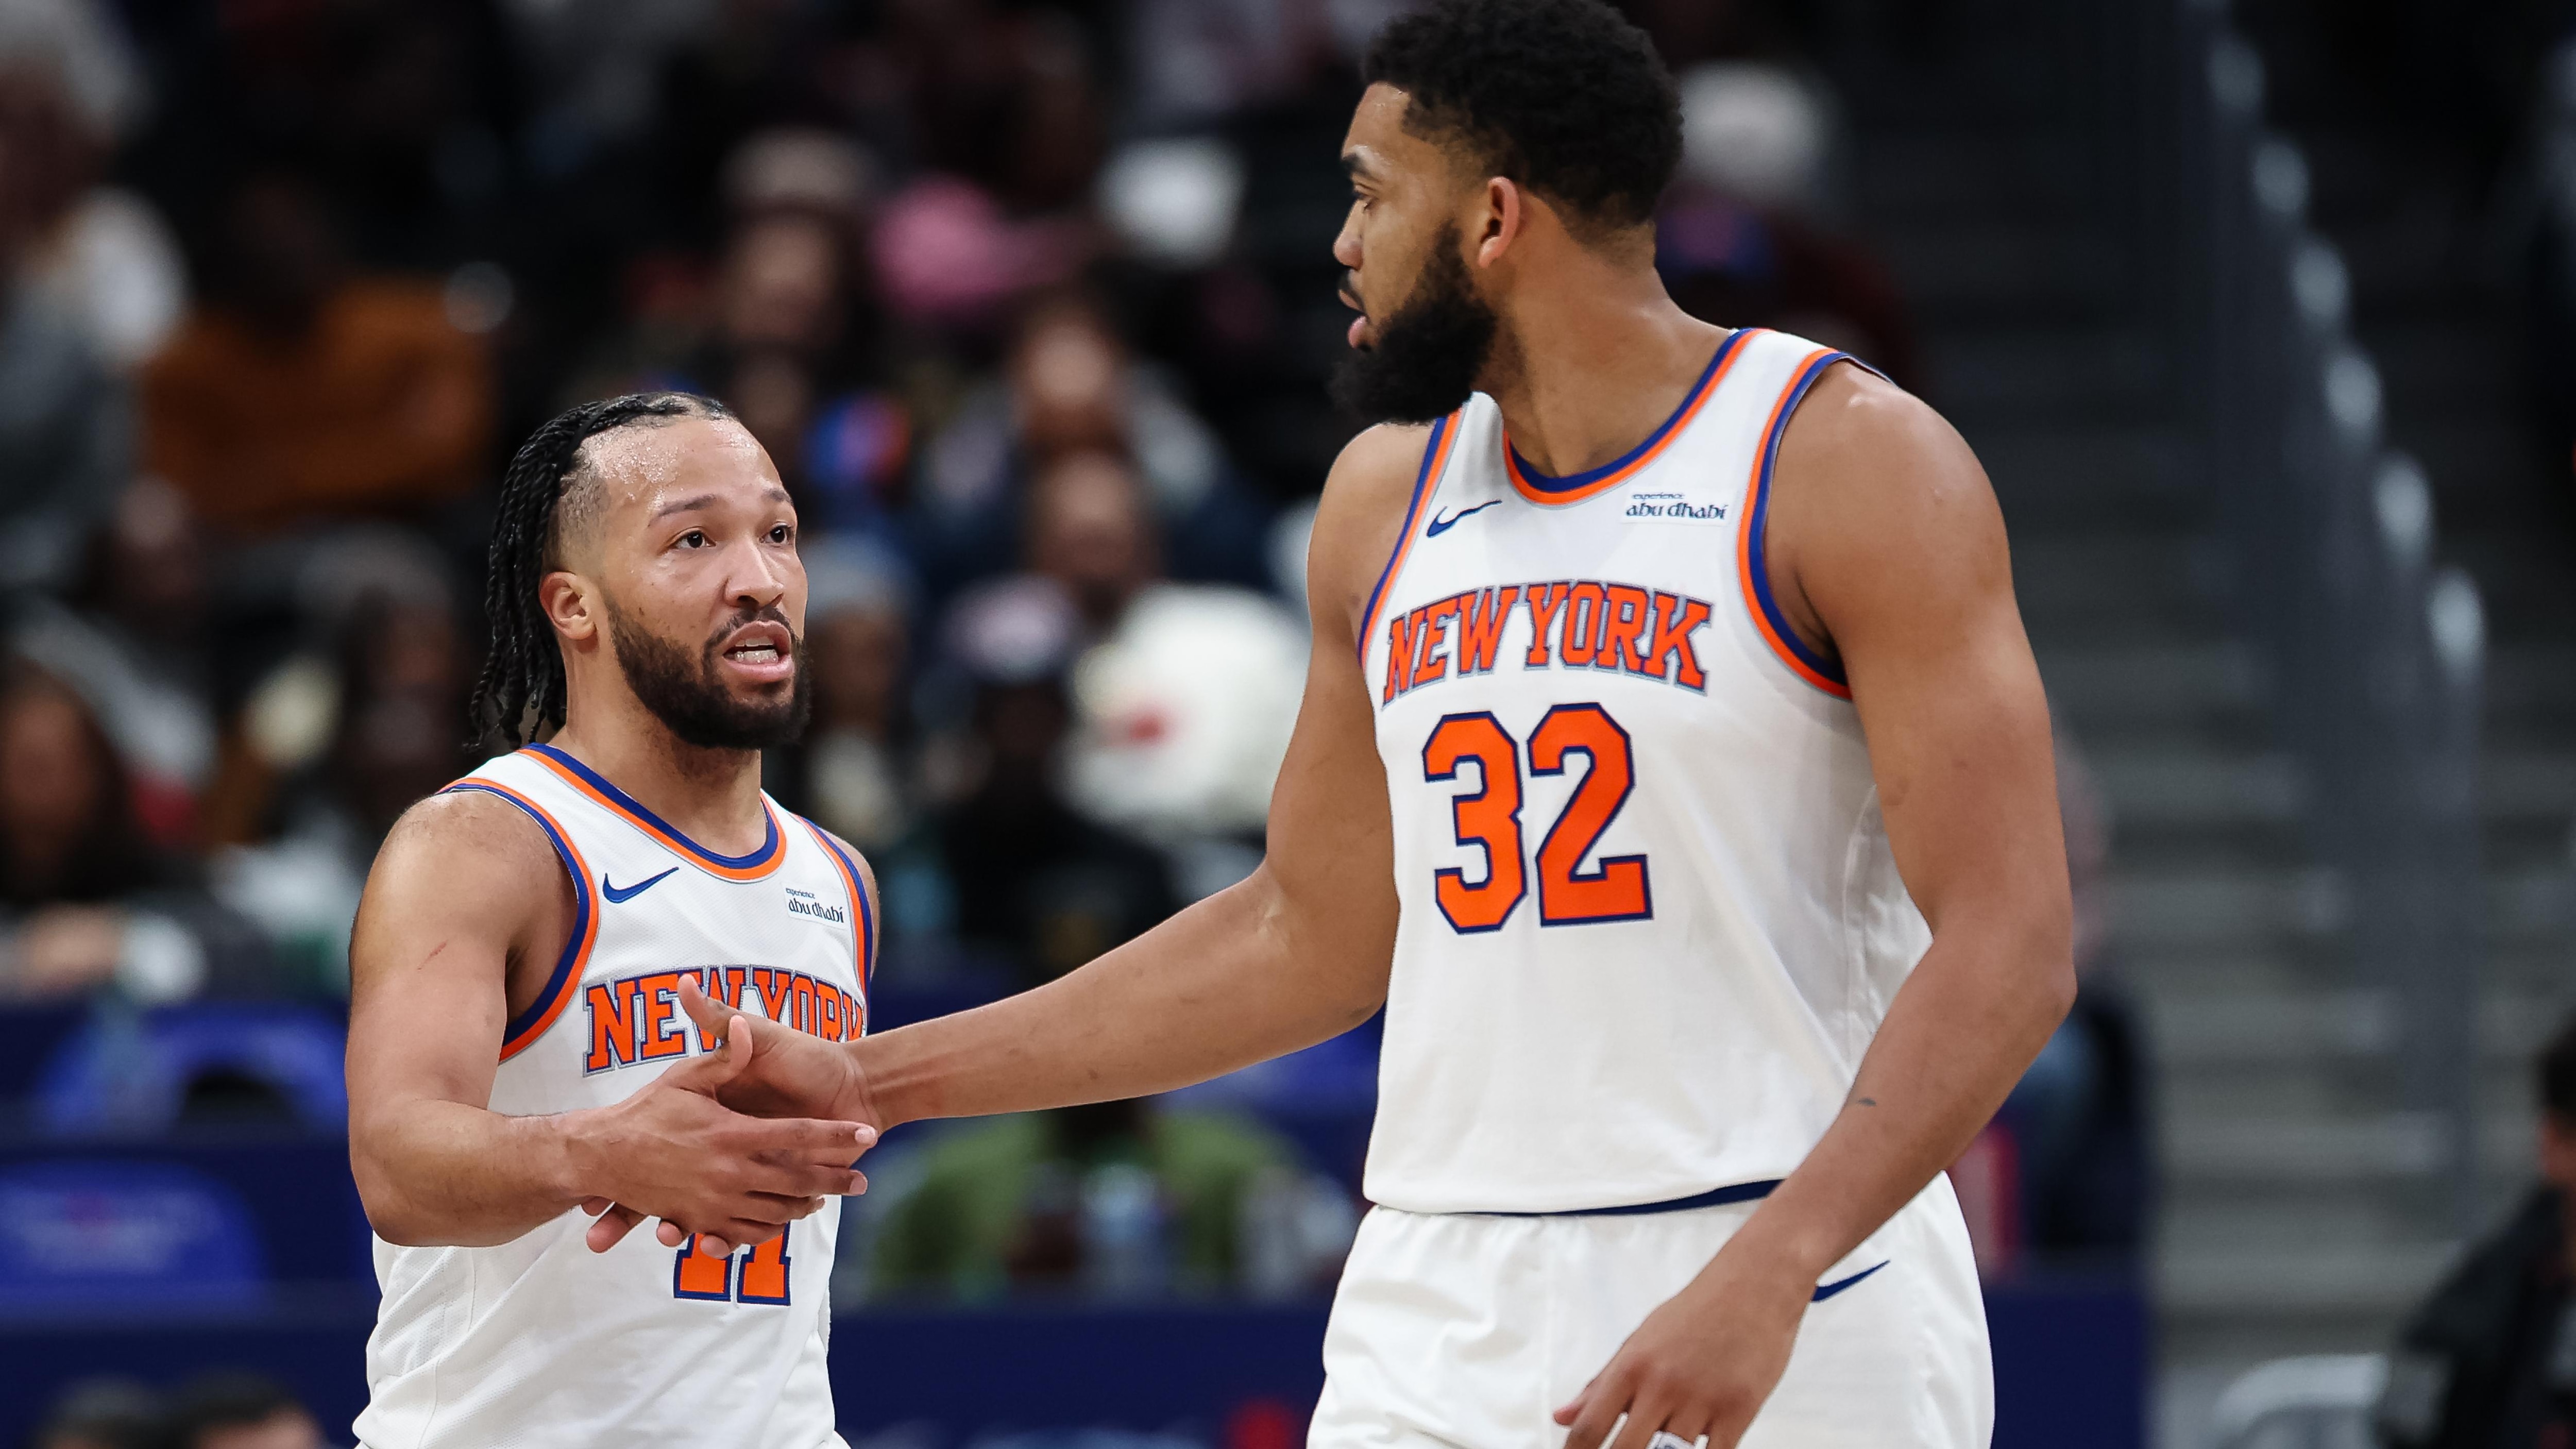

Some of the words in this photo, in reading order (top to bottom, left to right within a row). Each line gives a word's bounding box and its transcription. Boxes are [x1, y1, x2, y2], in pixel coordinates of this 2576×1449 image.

[1626, 502, 1664, 517] abu
[1667, 502, 1728, 520] dhabi
[1382, 582, 1523, 711] NEW
[1523, 579, 1714, 697] YORK
[1422, 702, 1654, 935] 32
[788, 898, 812, 915] abu
[811, 902, 844, 923] dhabi
